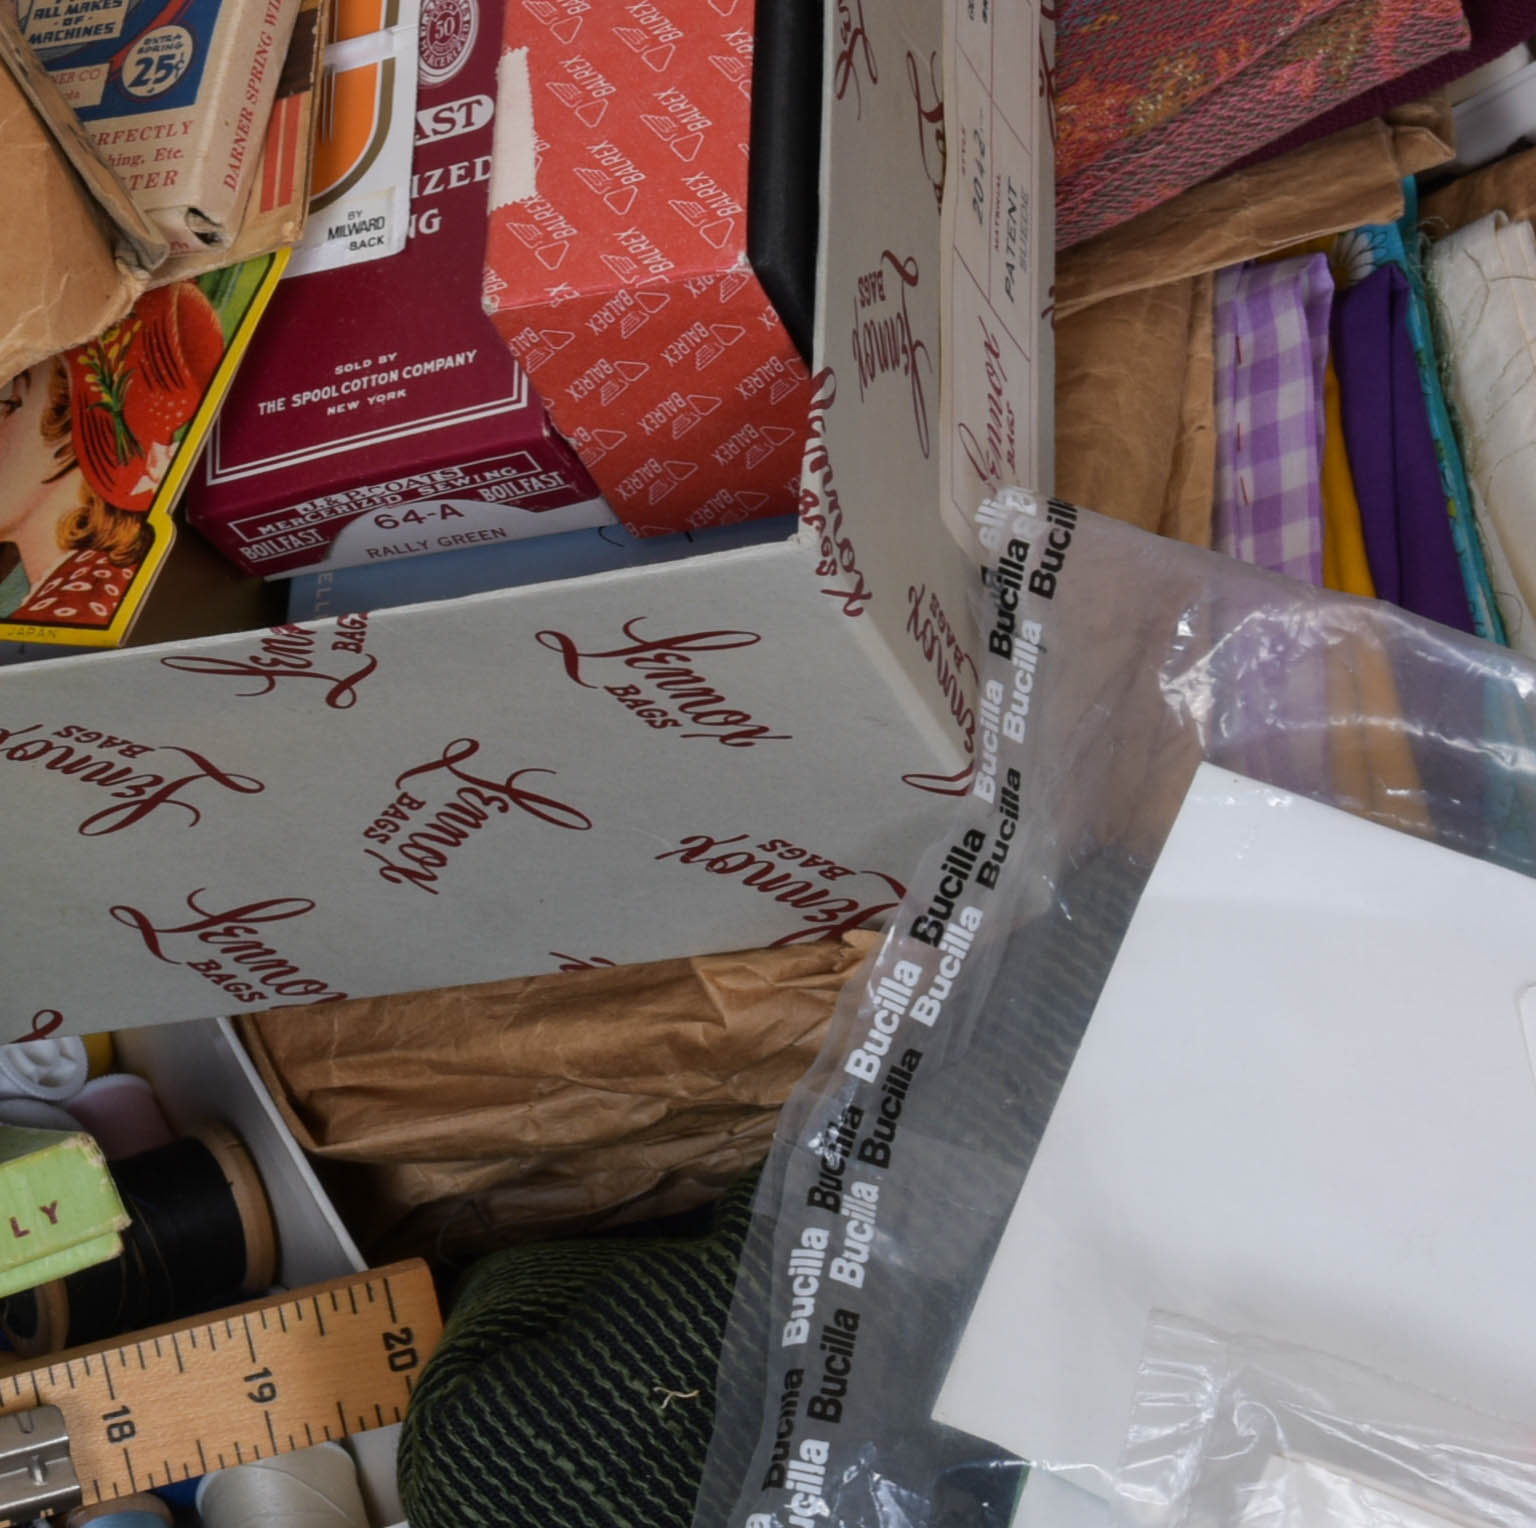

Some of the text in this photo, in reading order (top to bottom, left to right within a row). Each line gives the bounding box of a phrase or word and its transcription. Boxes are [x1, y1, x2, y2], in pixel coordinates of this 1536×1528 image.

[28, 22, 116, 44] MACHINES
[33, 6, 61, 21] ALL
[434, 17, 456, 39] 50
[625, 0, 684, 43] BALREX
[560, 54, 616, 98] BALREX
[223, 107, 255, 192] DARNER
[245, 31, 273, 108] SPRING
[654, 87, 712, 132] BALREX
[587, 140, 646, 185] BALREX
[347, 210, 363, 221] BY
[682, 171, 743, 217] BALREX
[328, 216, 385, 241] MILWARD
[349, 235, 385, 252] BACK
[613, 226, 674, 273] BALREX
[1004, 175, 1018, 304] PATENT
[584, 288, 634, 336] BALREX
[334, 352, 398, 375] SOLD BY
[660, 322, 711, 367] BALREX
[258, 349, 477, 416] THE SPOOL COTTON COMPANY
[565, 358, 614, 402] BALREX
[735, 356, 785, 400] BALREX
[326, 388, 408, 416] NEW YORK
[638, 391, 688, 437] BALREX
[710, 423, 760, 466] BALREX
[256, 493, 404, 535] MERCERIZED
[418, 466, 518, 497] SEWING
[478, 471, 566, 503] BOILFAST
[614, 458, 662, 502] BALREX
[374, 503, 464, 530] 64-A
[686, 488, 734, 529] BALREX
[239, 528, 325, 561] BOILFAST
[366, 527, 508, 560] RALLY GREEN
[988, 537, 1031, 661] Bucilla
[534, 616, 793, 749] Lennox
[1002, 619, 1043, 744] Bucilla
[602, 683, 684, 730] BAGS
[49, 723, 156, 758] BAGS
[973, 679, 1005, 804] Bucilla
[360, 738, 592, 895] Lennox
[360, 789, 425, 846] BAGS
[976, 767, 1022, 890] Bucilla
[756, 837, 859, 881] BAGS
[911, 827, 987, 949] Bucilla
[184, 959, 269, 1004] BAGS
[910, 906, 985, 1027] Bucilla
[844, 959, 923, 1085] Bucilla
[858, 1047, 924, 1170] Bucilla
[830, 1180, 880, 1290] Bucilla
[782, 1226, 830, 1349] Bucilla
[380, 1325, 420, 1375] 20
[807, 1306, 862, 1424] Bucilla
